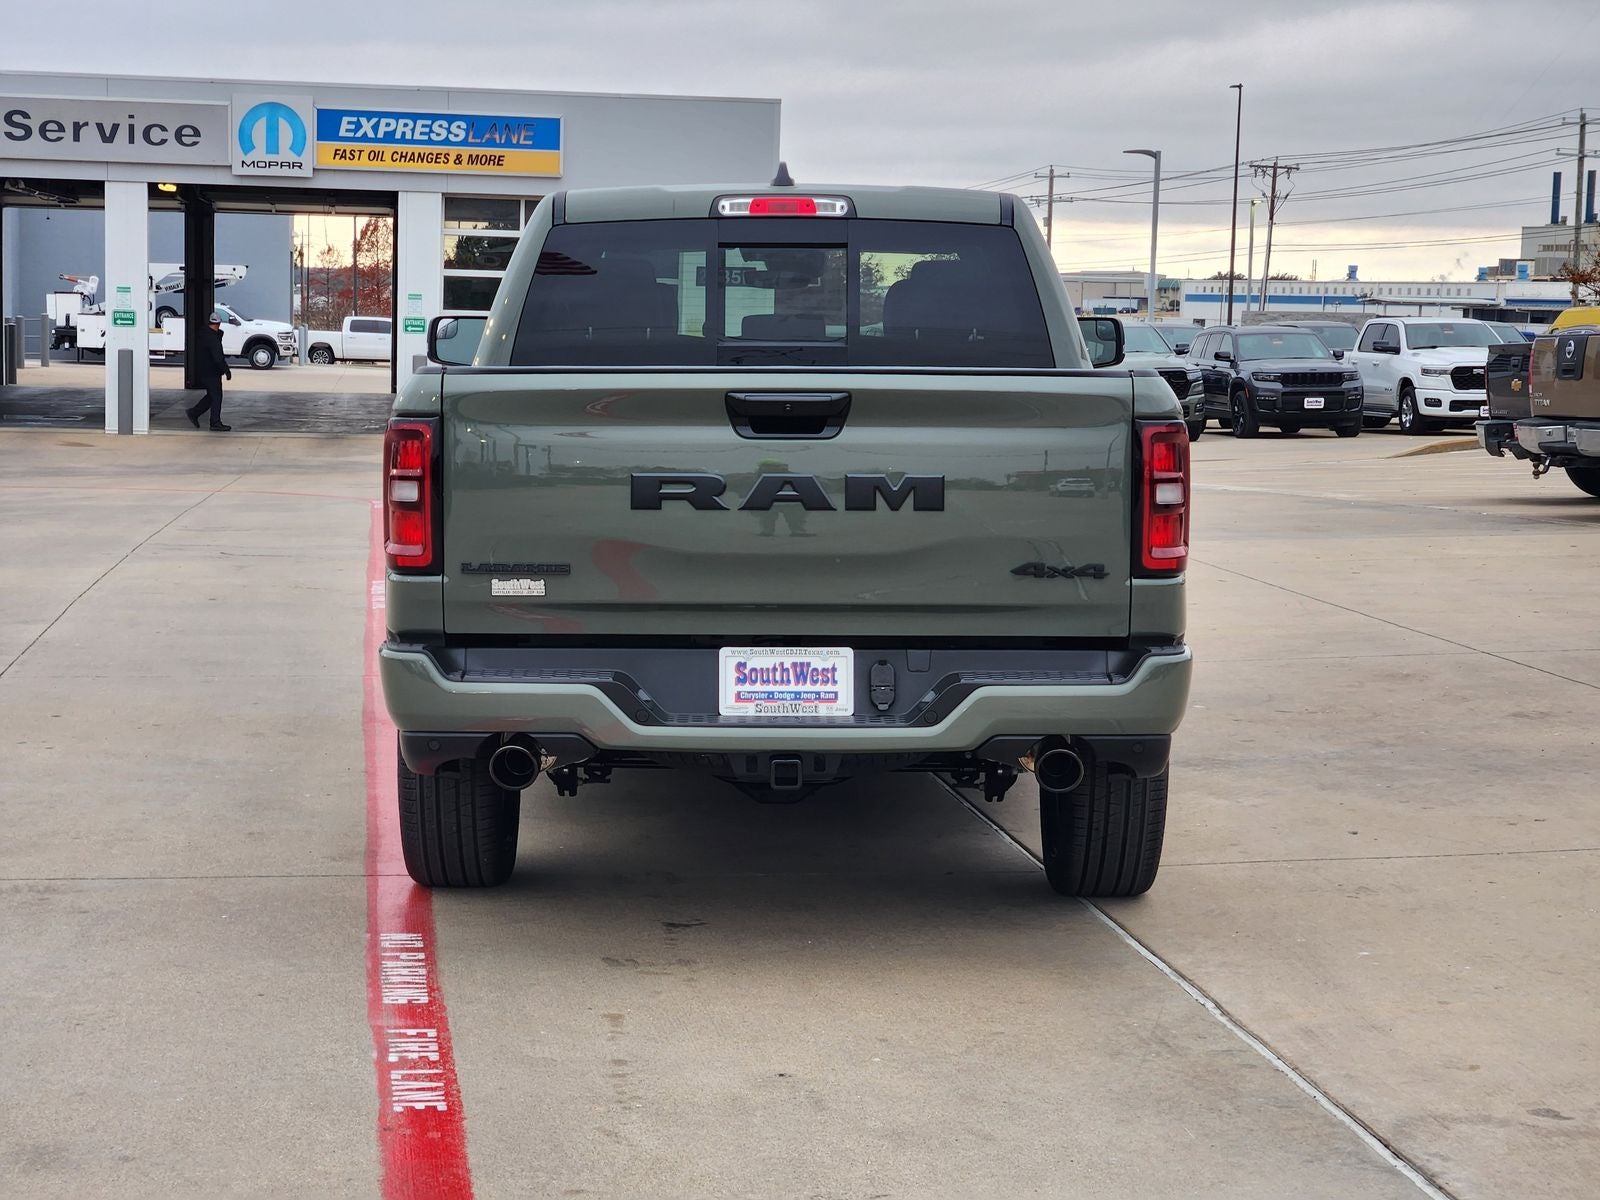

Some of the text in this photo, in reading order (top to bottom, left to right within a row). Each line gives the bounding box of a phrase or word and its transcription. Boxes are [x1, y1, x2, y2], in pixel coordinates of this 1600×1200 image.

[4, 109, 201, 147] Service
[242, 160, 303, 169] MOPAR
[333, 148, 505, 166] FAST OIL CHANGES & MORE
[631, 473, 945, 511] RAM
[461, 563, 570, 575] LARAMIE
[492, 579, 545, 590] SouthWest
[735, 661, 838, 686] SouthWest
[740, 691, 836, 701] Chrysler Dodge Jeep Ram
[755, 703, 819, 714] SouthWest
[381, 952, 429, 1004] PARKING
[386, 1028, 448, 1112] FIRE LANE
